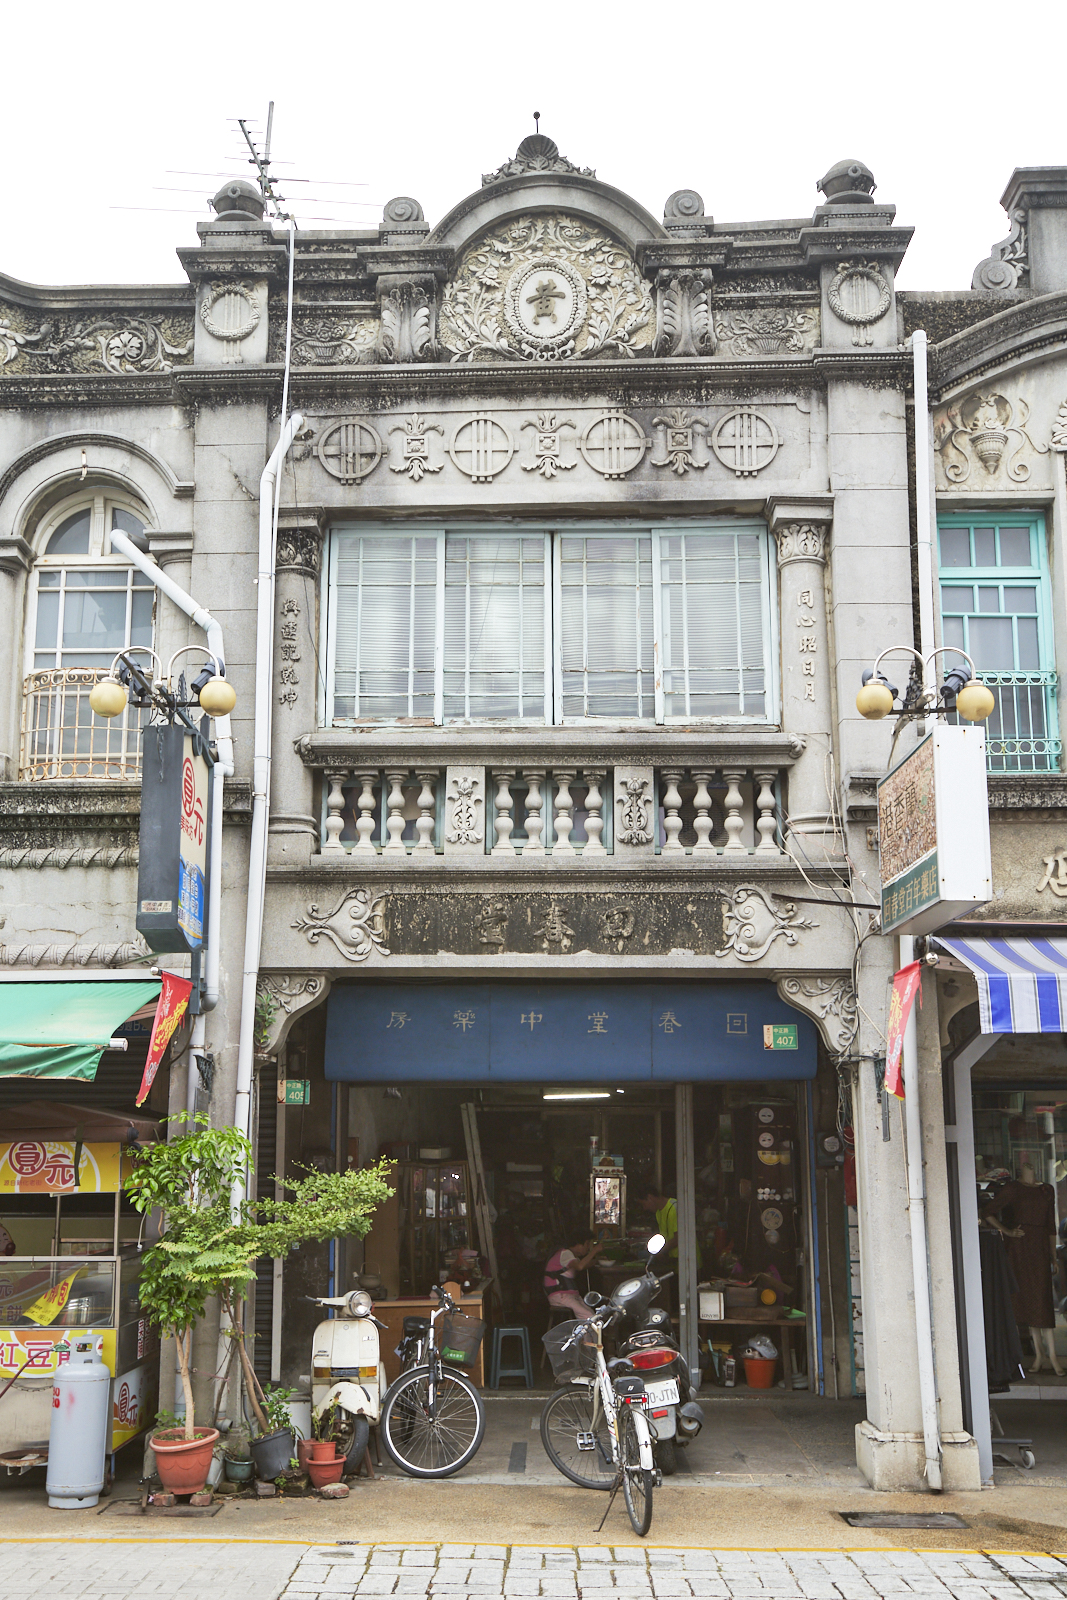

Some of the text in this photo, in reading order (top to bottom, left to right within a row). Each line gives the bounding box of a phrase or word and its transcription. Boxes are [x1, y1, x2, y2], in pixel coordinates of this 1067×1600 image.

[796, 589, 818, 702] 同心昭日月
[777, 1036, 794, 1045] 407
[289, 1091, 304, 1100] 405
